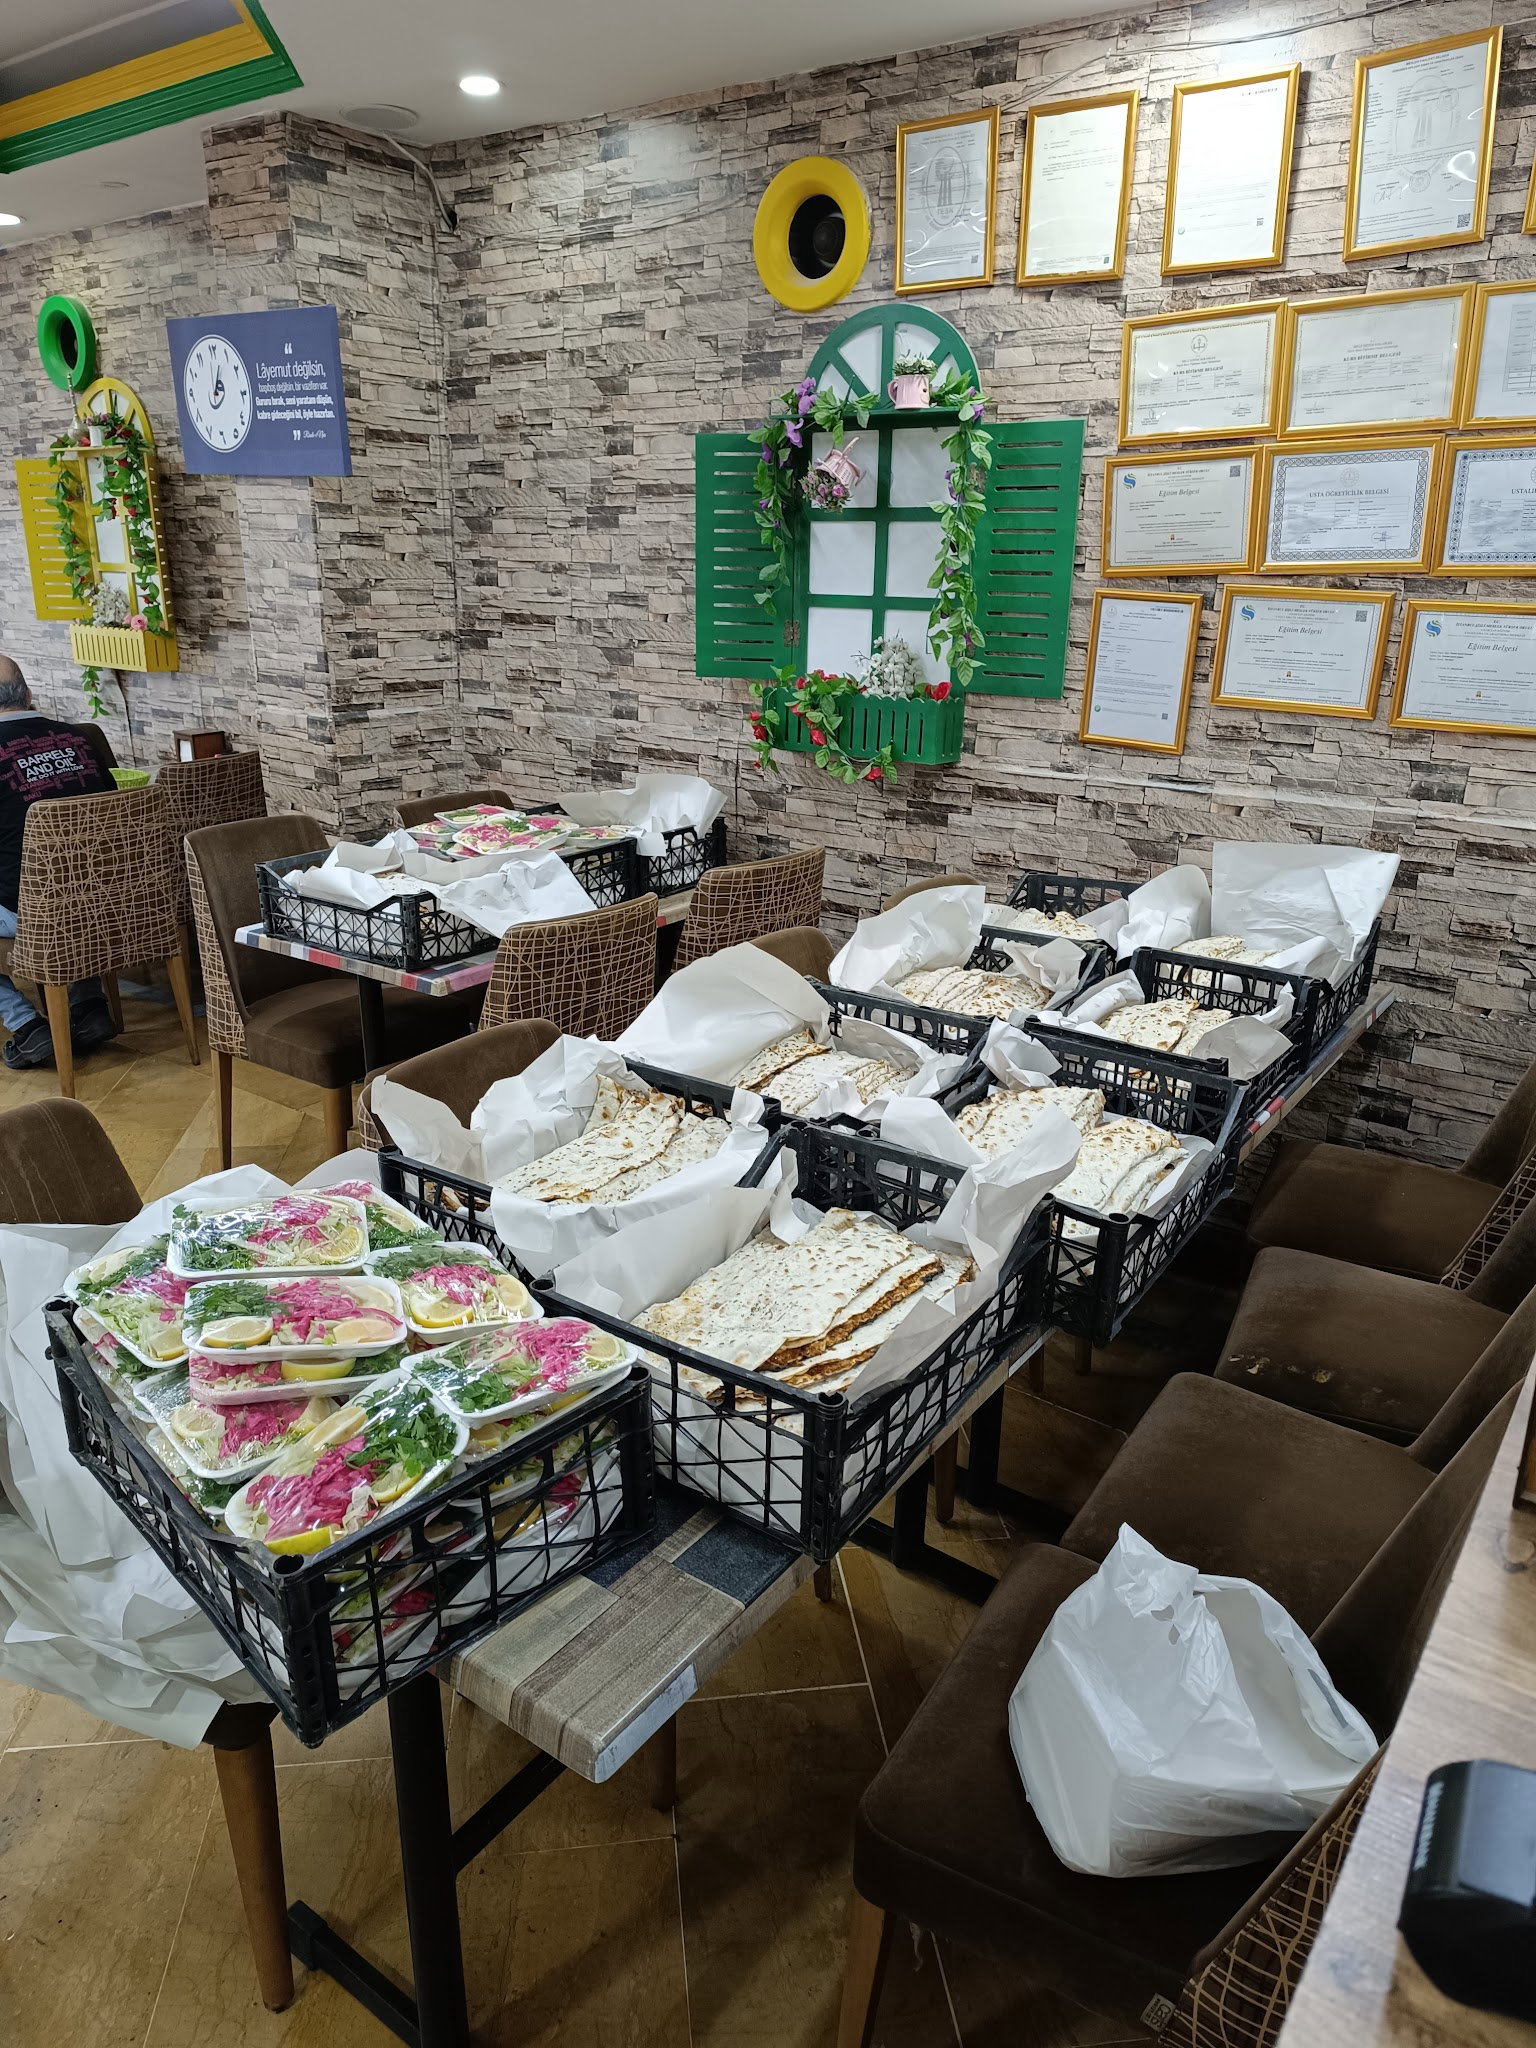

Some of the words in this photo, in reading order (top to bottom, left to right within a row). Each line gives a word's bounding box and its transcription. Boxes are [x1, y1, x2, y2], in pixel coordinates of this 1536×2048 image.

[256, 362, 292, 381] Lâyemut
[292, 360, 326, 379] değilsin,
[286, 395, 296, 404] seni
[303, 409, 313, 420] öyle
[1179, 488, 1200, 496] Belgesi
[1325, 489, 1364, 497] ÖĞRETİCİLİK
[1278, 626, 1298, 634] Eğitim
[1300, 626, 1322, 635] Belgesi
[1467, 642, 1491, 651] Eğitim
[1492, 644, 1519, 652] Belgesi
[17, 747, 76, 769] BARRELS
[26, 763, 53, 778] AND
[26, 775, 38, 783] WE
[38, 772, 49, 781] DO
[55, 767, 71, 775] WITH
[23, 791, 42, 801] BAKU
